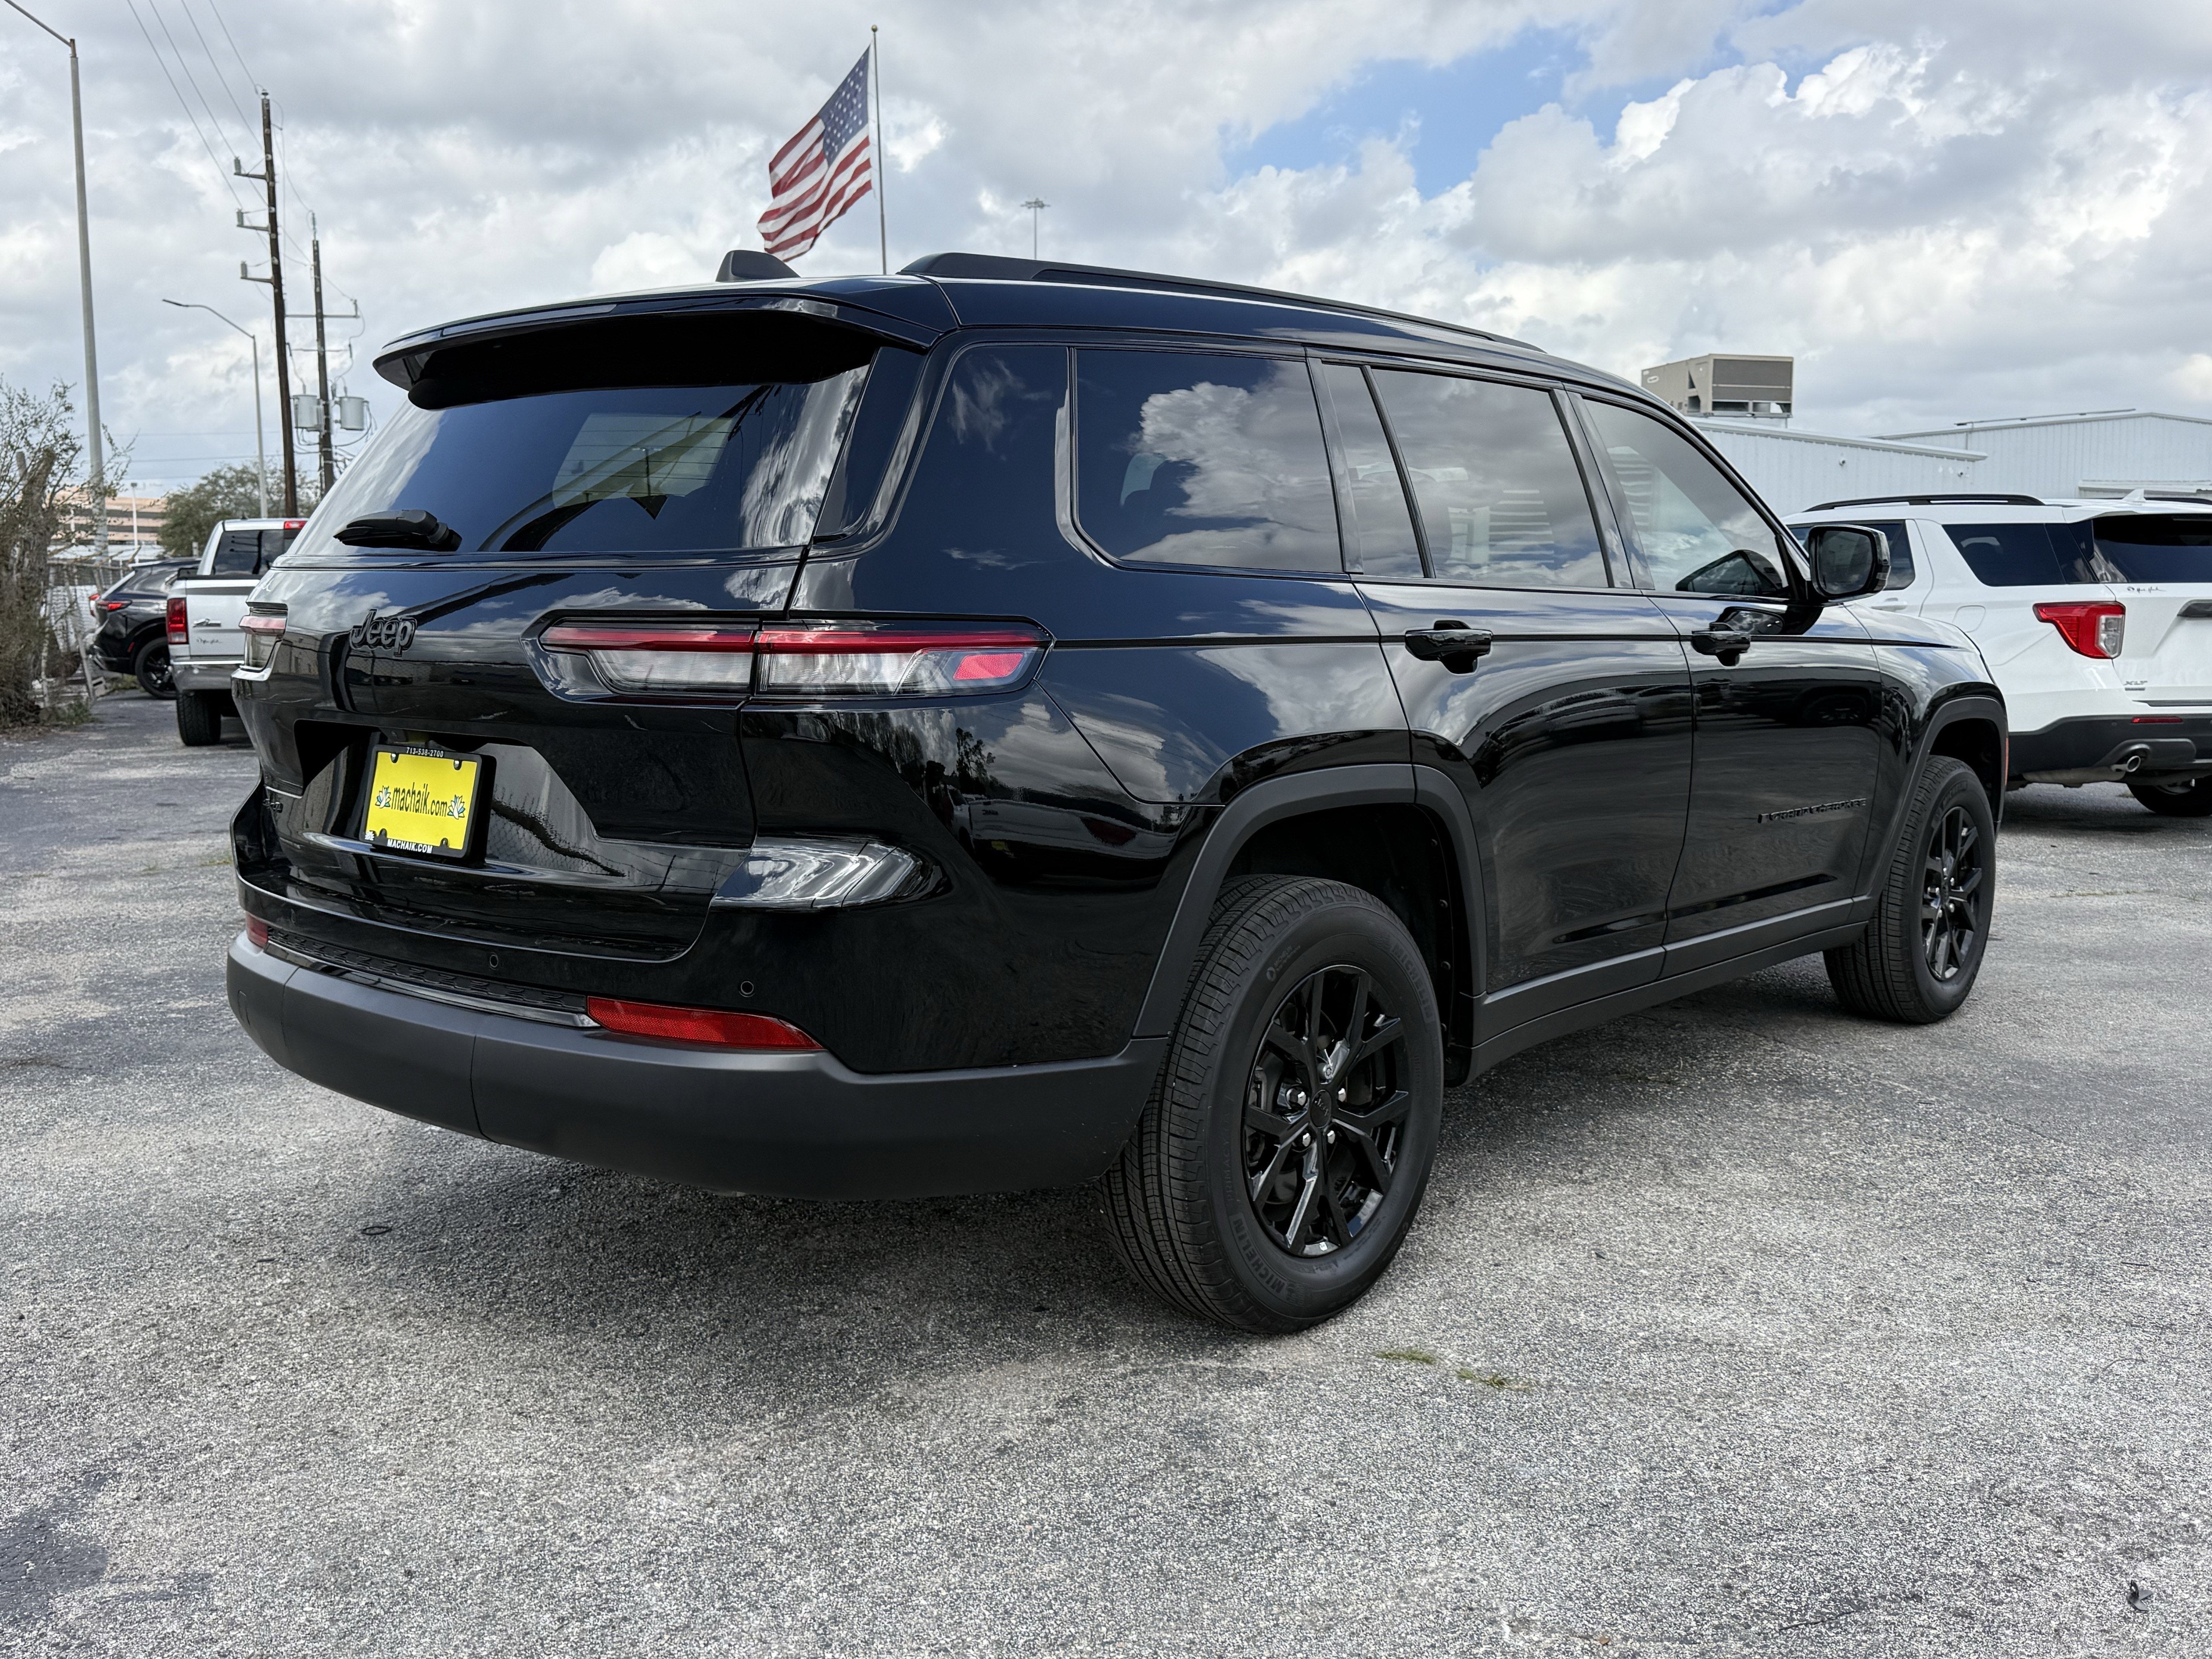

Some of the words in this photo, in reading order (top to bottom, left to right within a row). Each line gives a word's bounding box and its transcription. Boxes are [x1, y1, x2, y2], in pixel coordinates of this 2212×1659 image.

[350, 608, 417, 657] Jeep
[391, 782, 447, 817] machaik.com
[387, 839, 433, 854] MACHAIK.COM
[1231, 1218, 1285, 1294] MICHELIN
